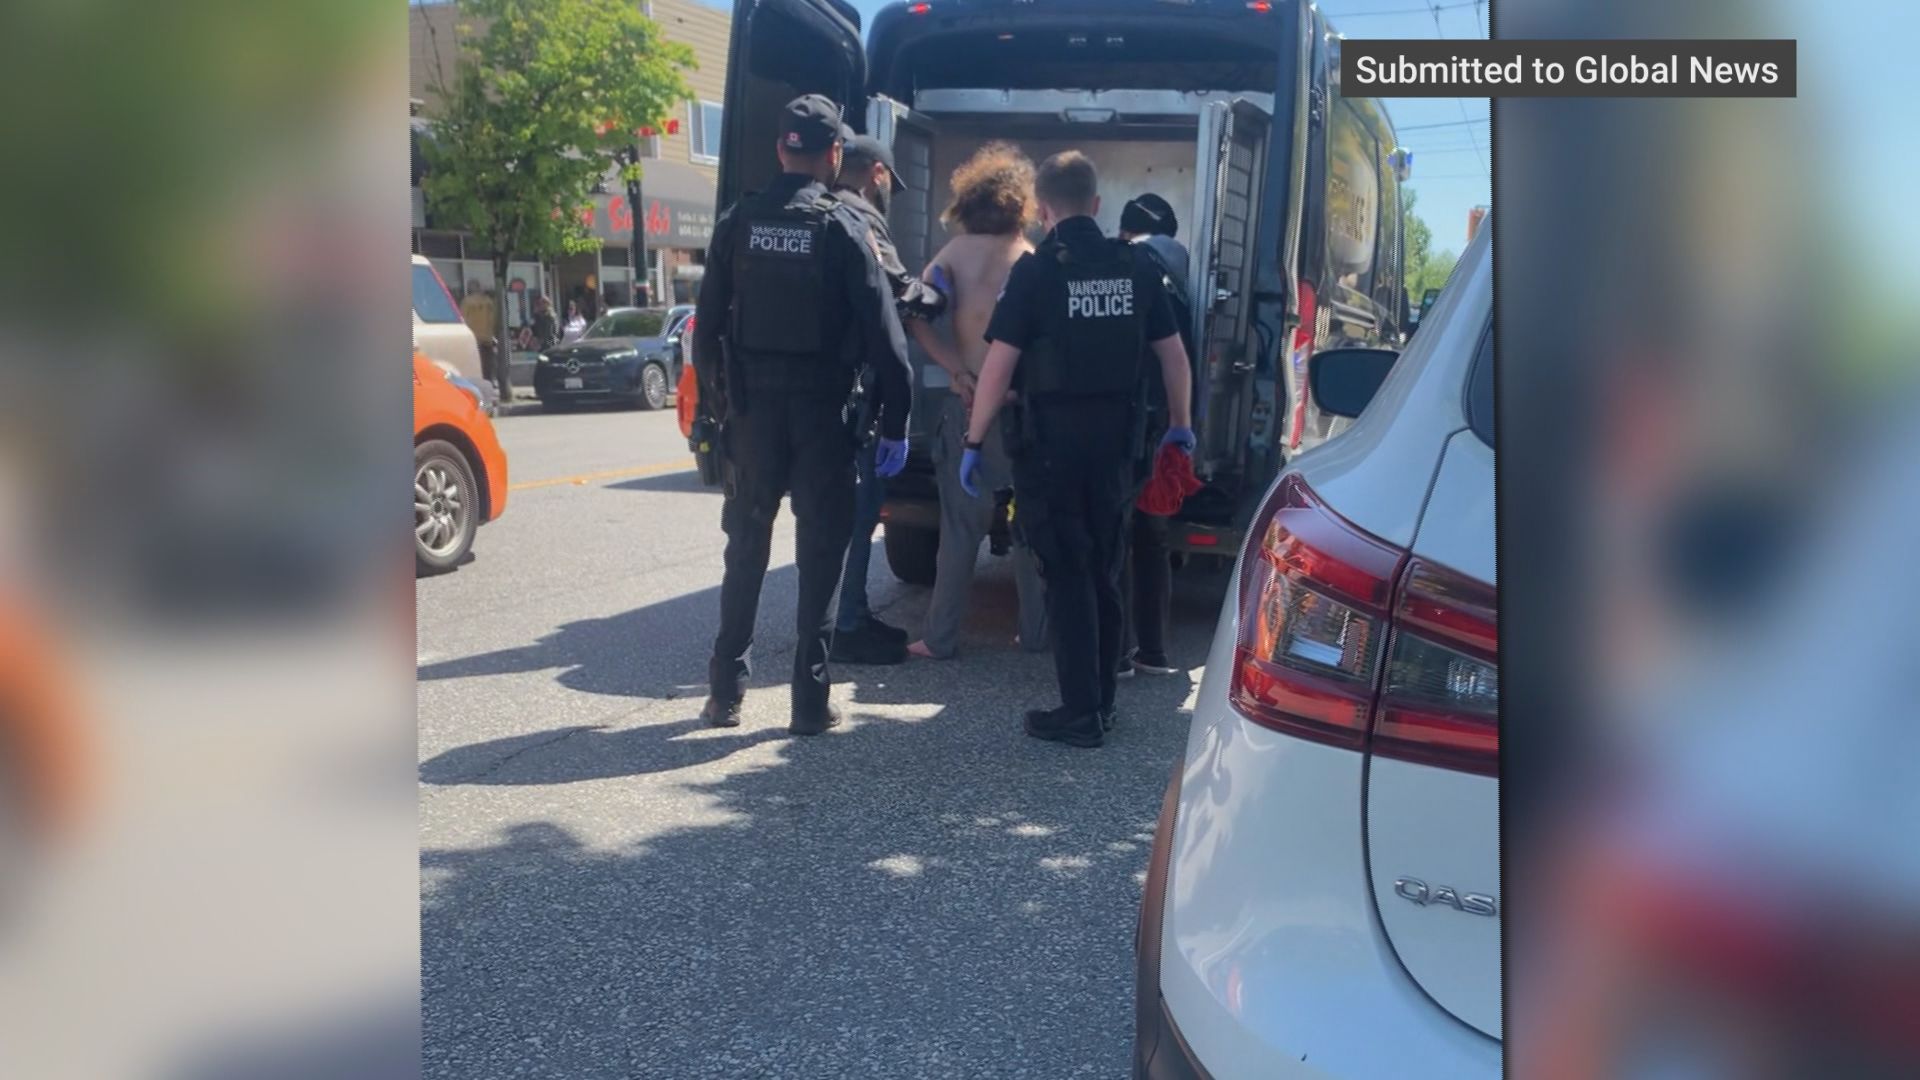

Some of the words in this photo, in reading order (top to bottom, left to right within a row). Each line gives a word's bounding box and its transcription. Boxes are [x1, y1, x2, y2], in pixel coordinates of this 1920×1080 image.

[608, 196, 671, 235] Suhi
[751, 225, 813, 239] VANCOUVER
[749, 234, 812, 254] POLICE
[1067, 278, 1133, 296] VANCOUVER
[1068, 294, 1134, 318] POLICE
[1394, 876, 1497, 917] QAS
